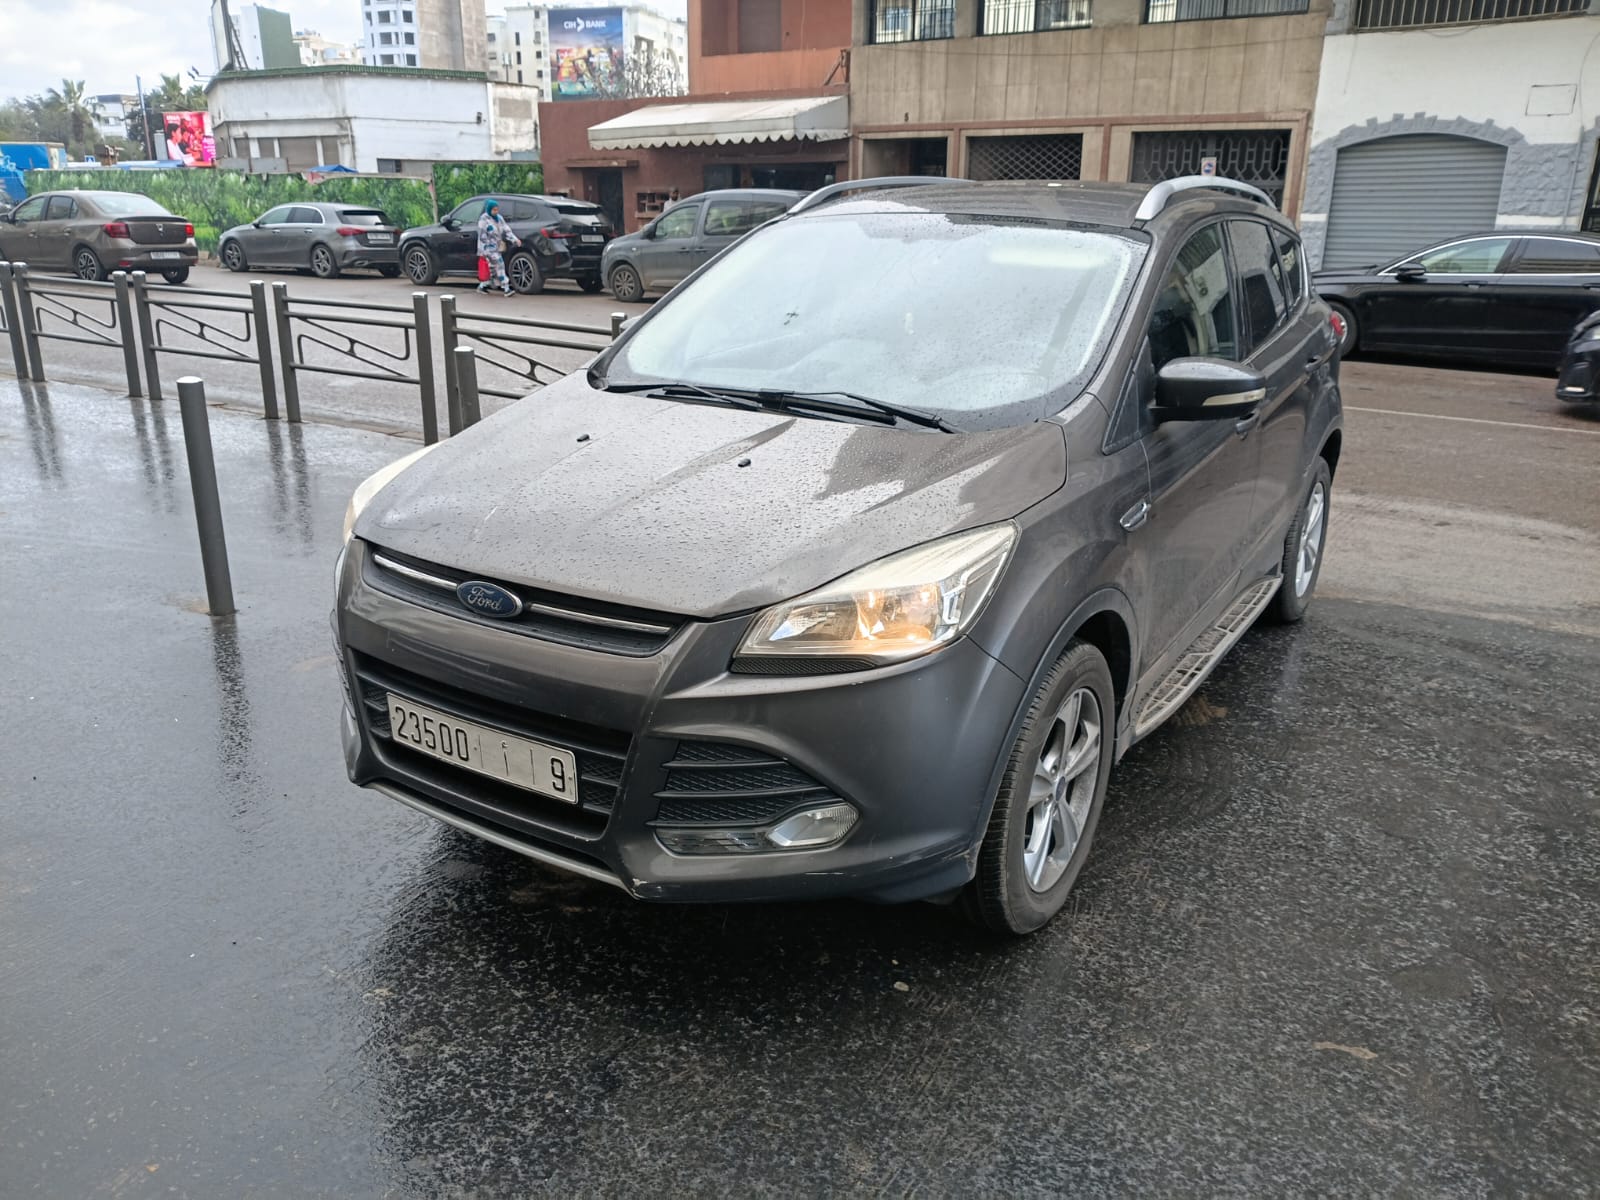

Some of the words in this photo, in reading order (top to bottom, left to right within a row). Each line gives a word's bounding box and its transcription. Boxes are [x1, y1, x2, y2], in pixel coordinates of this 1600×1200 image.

[563, 20, 576, 29] CIH
[585, 19, 606, 29] BANK
[467, 585, 504, 611] Ford
[394, 704, 470, 762] 23500
[550, 755, 566, 793] 9
